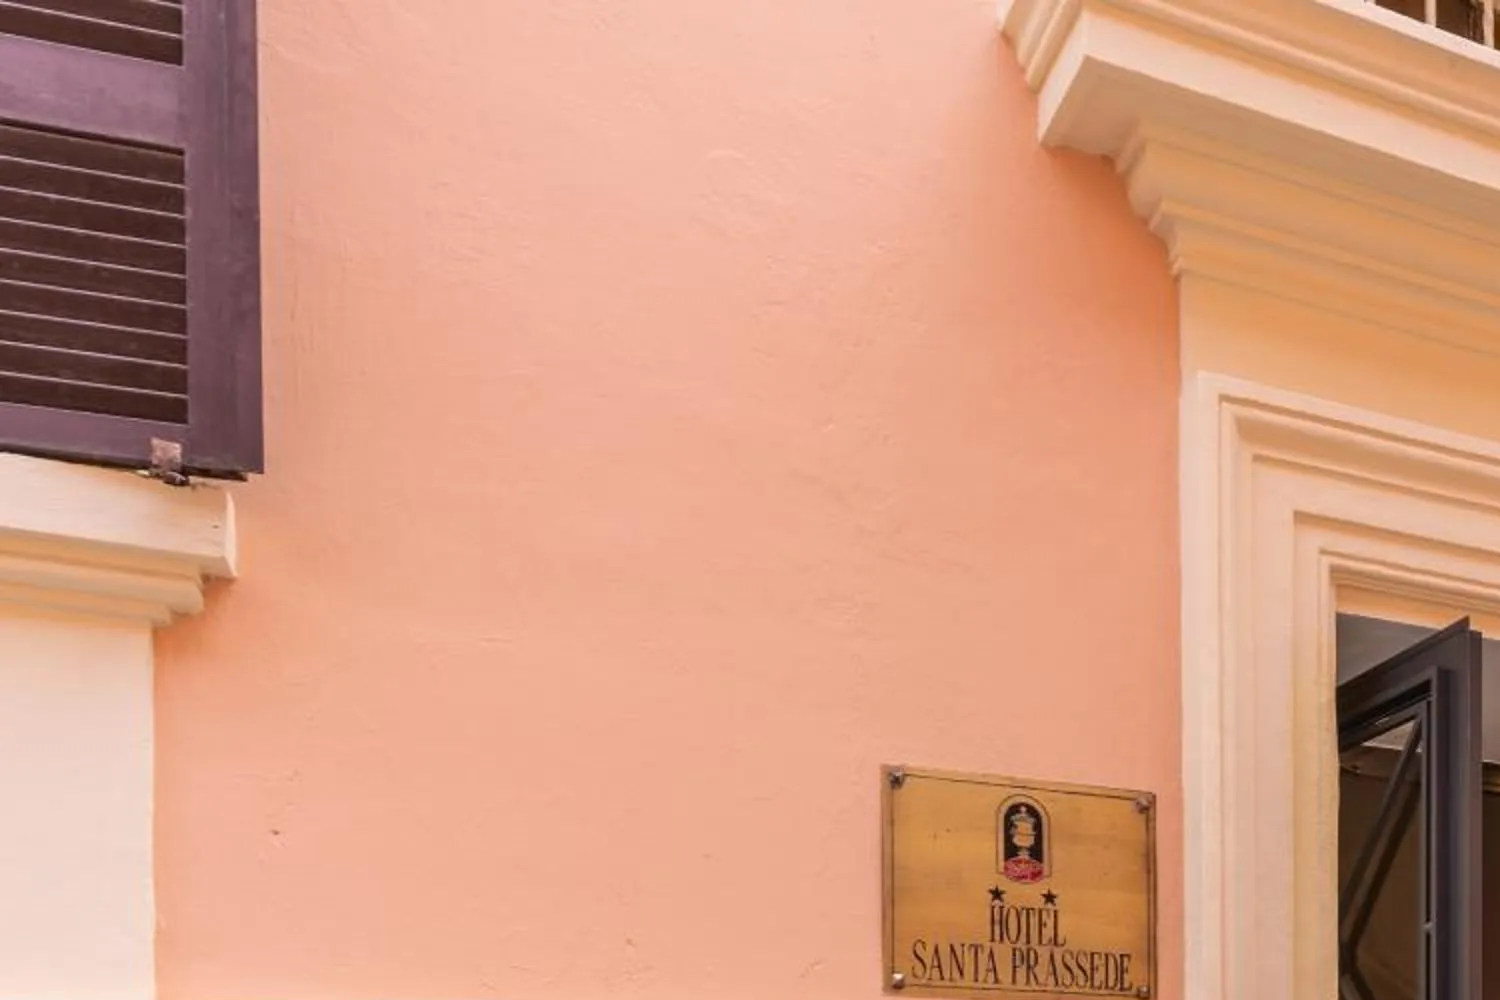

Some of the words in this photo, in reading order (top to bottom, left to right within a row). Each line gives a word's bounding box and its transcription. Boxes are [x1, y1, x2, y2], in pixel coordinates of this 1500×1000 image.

[989, 904, 1066, 947] HOTEL
[911, 939, 1000, 985] SANTA
[1011, 947, 1133, 992] PRASSEDE
